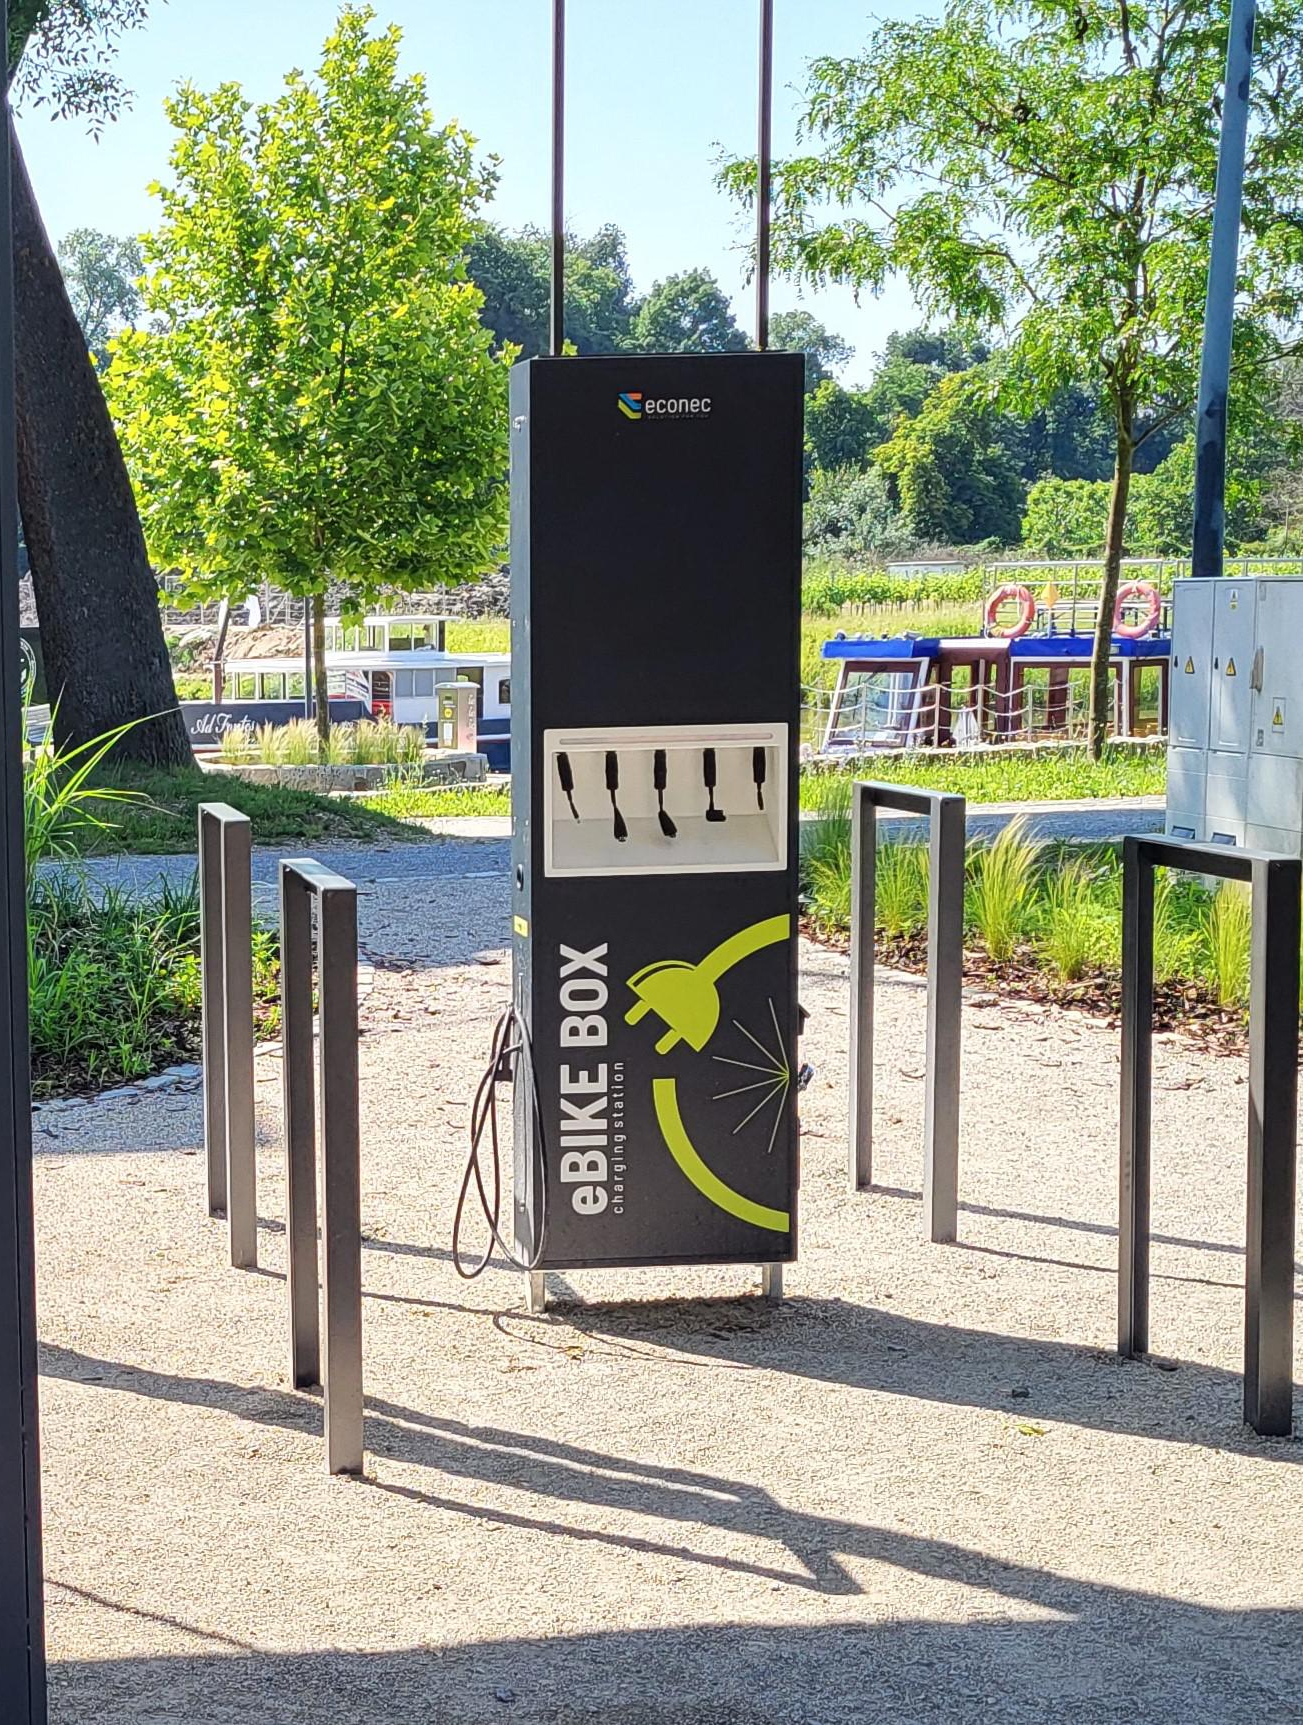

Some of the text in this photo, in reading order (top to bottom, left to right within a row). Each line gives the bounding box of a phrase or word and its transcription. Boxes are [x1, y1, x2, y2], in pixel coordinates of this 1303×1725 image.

[645, 398, 712, 414] econec
[190, 713, 216, 735] Ad
[559, 942, 609, 1215] eBIKE BOX
[611, 1062, 627, 1214] charging station
